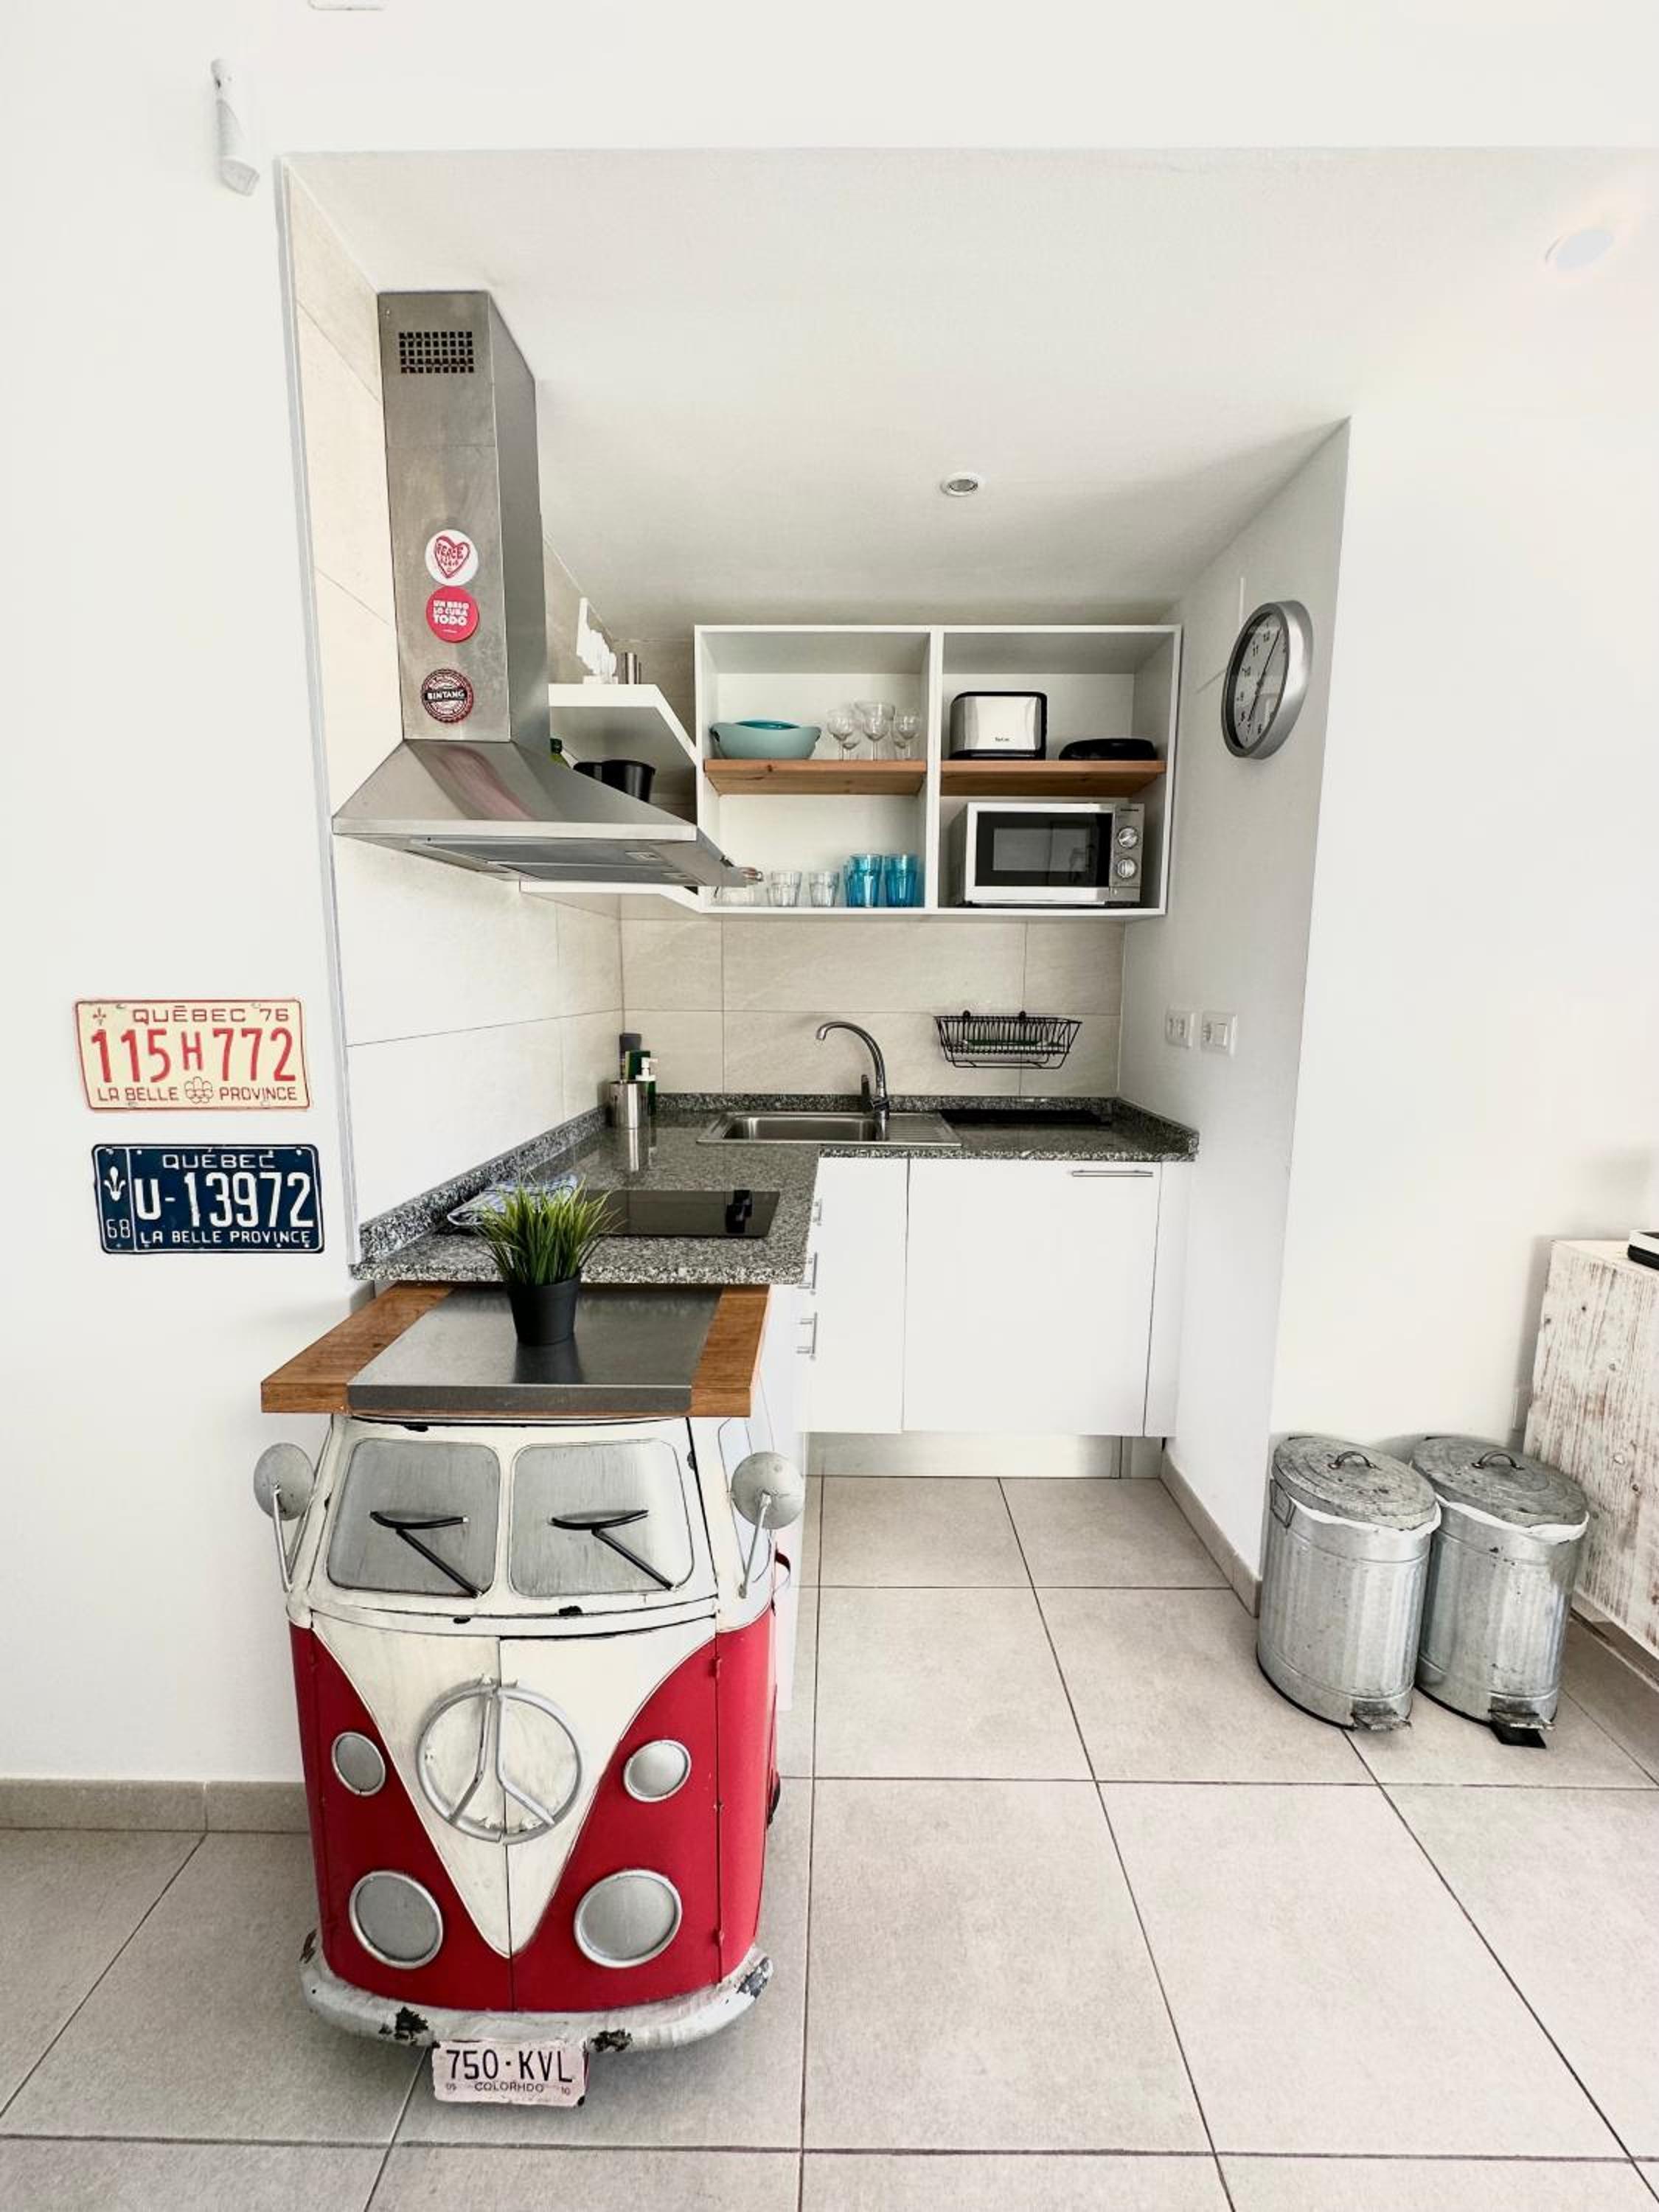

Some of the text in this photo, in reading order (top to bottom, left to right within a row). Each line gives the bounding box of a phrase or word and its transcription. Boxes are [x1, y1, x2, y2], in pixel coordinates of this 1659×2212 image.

[434, 607, 444, 615] LO
[434, 614, 468, 627] TODO
[427, 689, 465, 700] BINTANG
[133, 1005, 290, 1026] QUÉBEC 76
[97, 1086, 297, 1101] LA BELLE PROVINCE
[162, 1148, 276, 1170] QUÉBEC
[134, 1172, 314, 1228] U-13972
[106, 1218, 131, 1239] 68
[141, 1231, 310, 1244] LA BELLE PROVINCE
